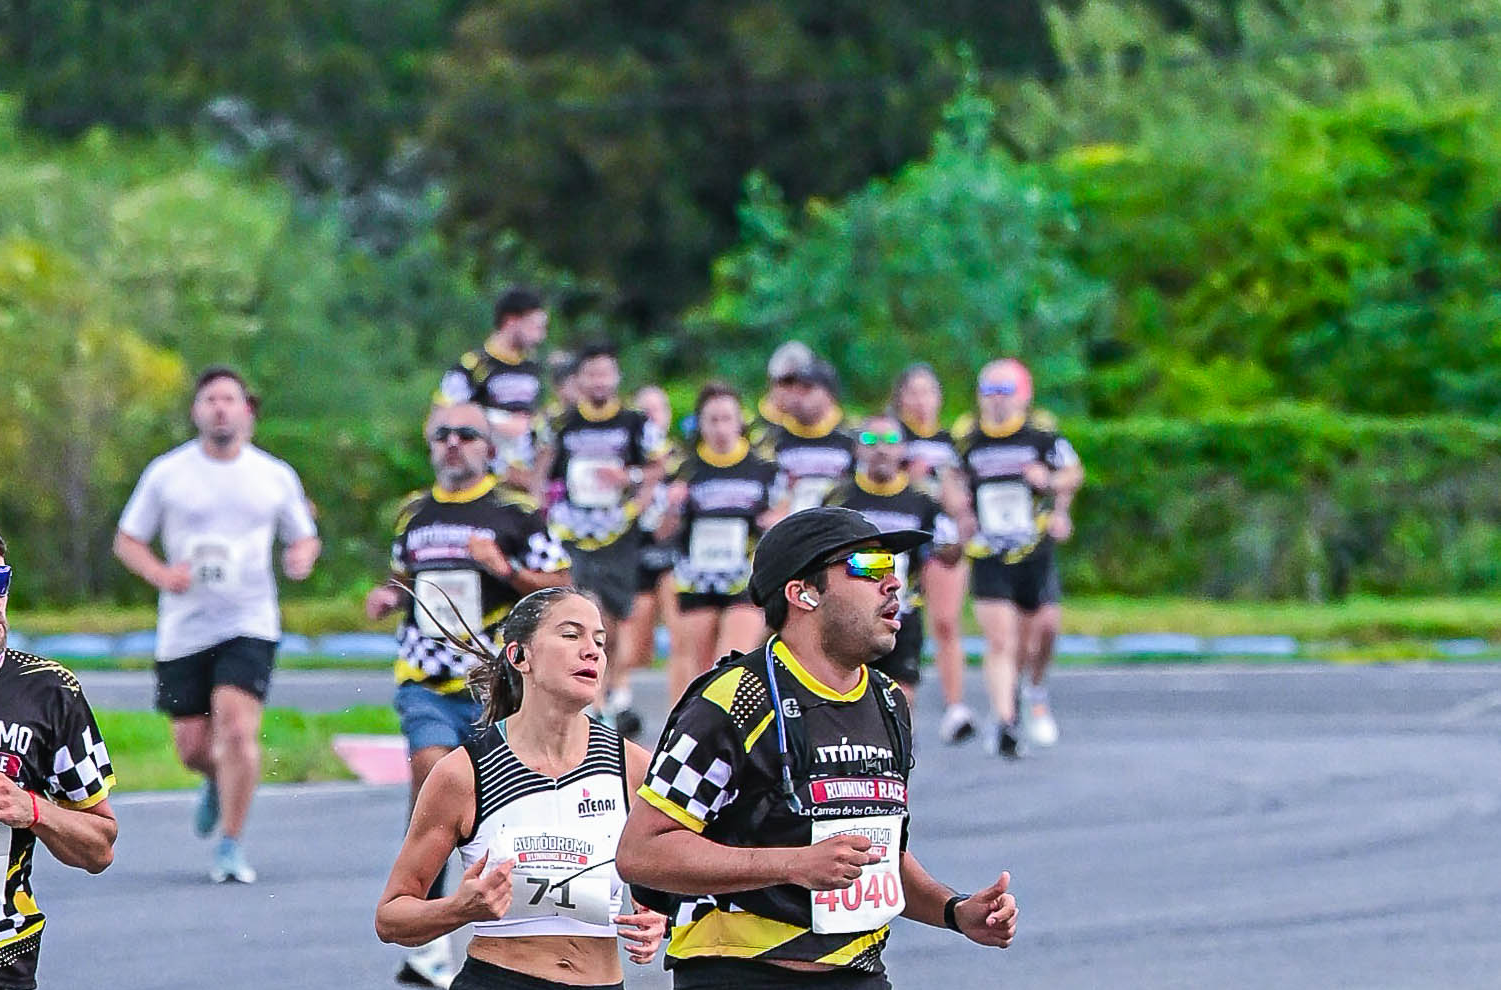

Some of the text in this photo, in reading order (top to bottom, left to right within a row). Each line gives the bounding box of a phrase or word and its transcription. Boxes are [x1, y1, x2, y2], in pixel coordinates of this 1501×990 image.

[824, 782, 905, 803] RUNNING RACE
[578, 799, 616, 815] ATENAS
[799, 807, 810, 816] La
[812, 806, 841, 816] Carrera
[842, 806, 852, 816] de
[514, 832, 594, 856] AUTÓDROMO
[526, 877, 576, 910] 71
[814, 871, 899, 912] 4040
